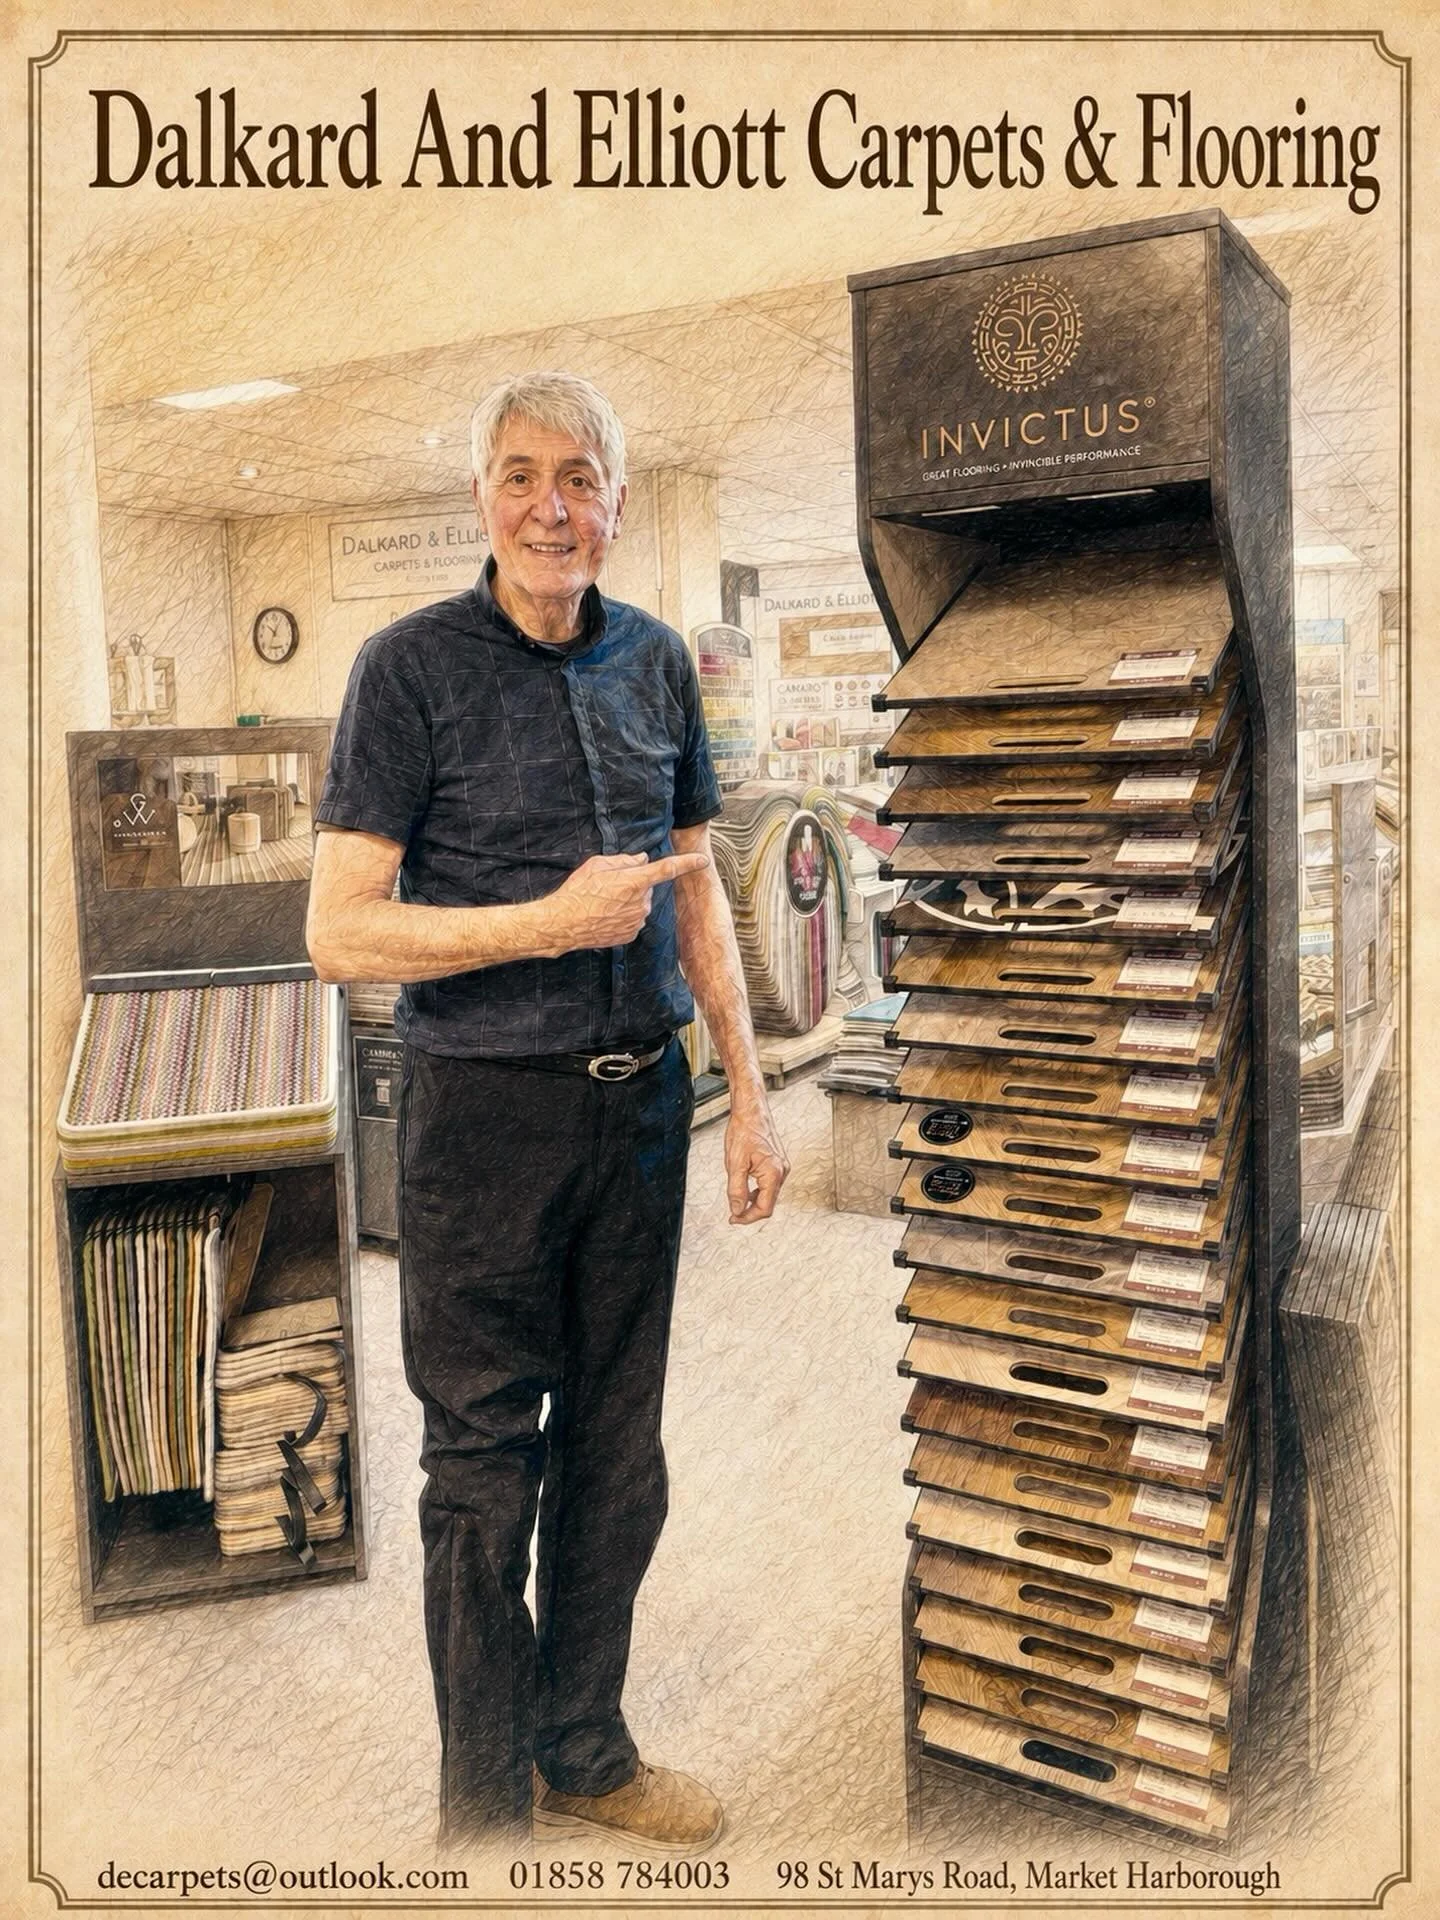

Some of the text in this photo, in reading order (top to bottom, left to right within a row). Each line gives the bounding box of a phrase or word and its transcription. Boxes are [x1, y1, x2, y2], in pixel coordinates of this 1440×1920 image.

[923, 399, 1141, 460] INVICTUS
[922, 469, 951, 482] GREAT
[952, 463, 1001, 479] FLOORING
[1064, 445, 1142, 464] PERFORMANCE
[342, 533, 422, 556] DALKARD
[427, 530, 440, 548] &
[374, 559, 420, 573] CARPETS
[764, 598, 821, 613] DALKARD
[825, 595, 834, 608] &
